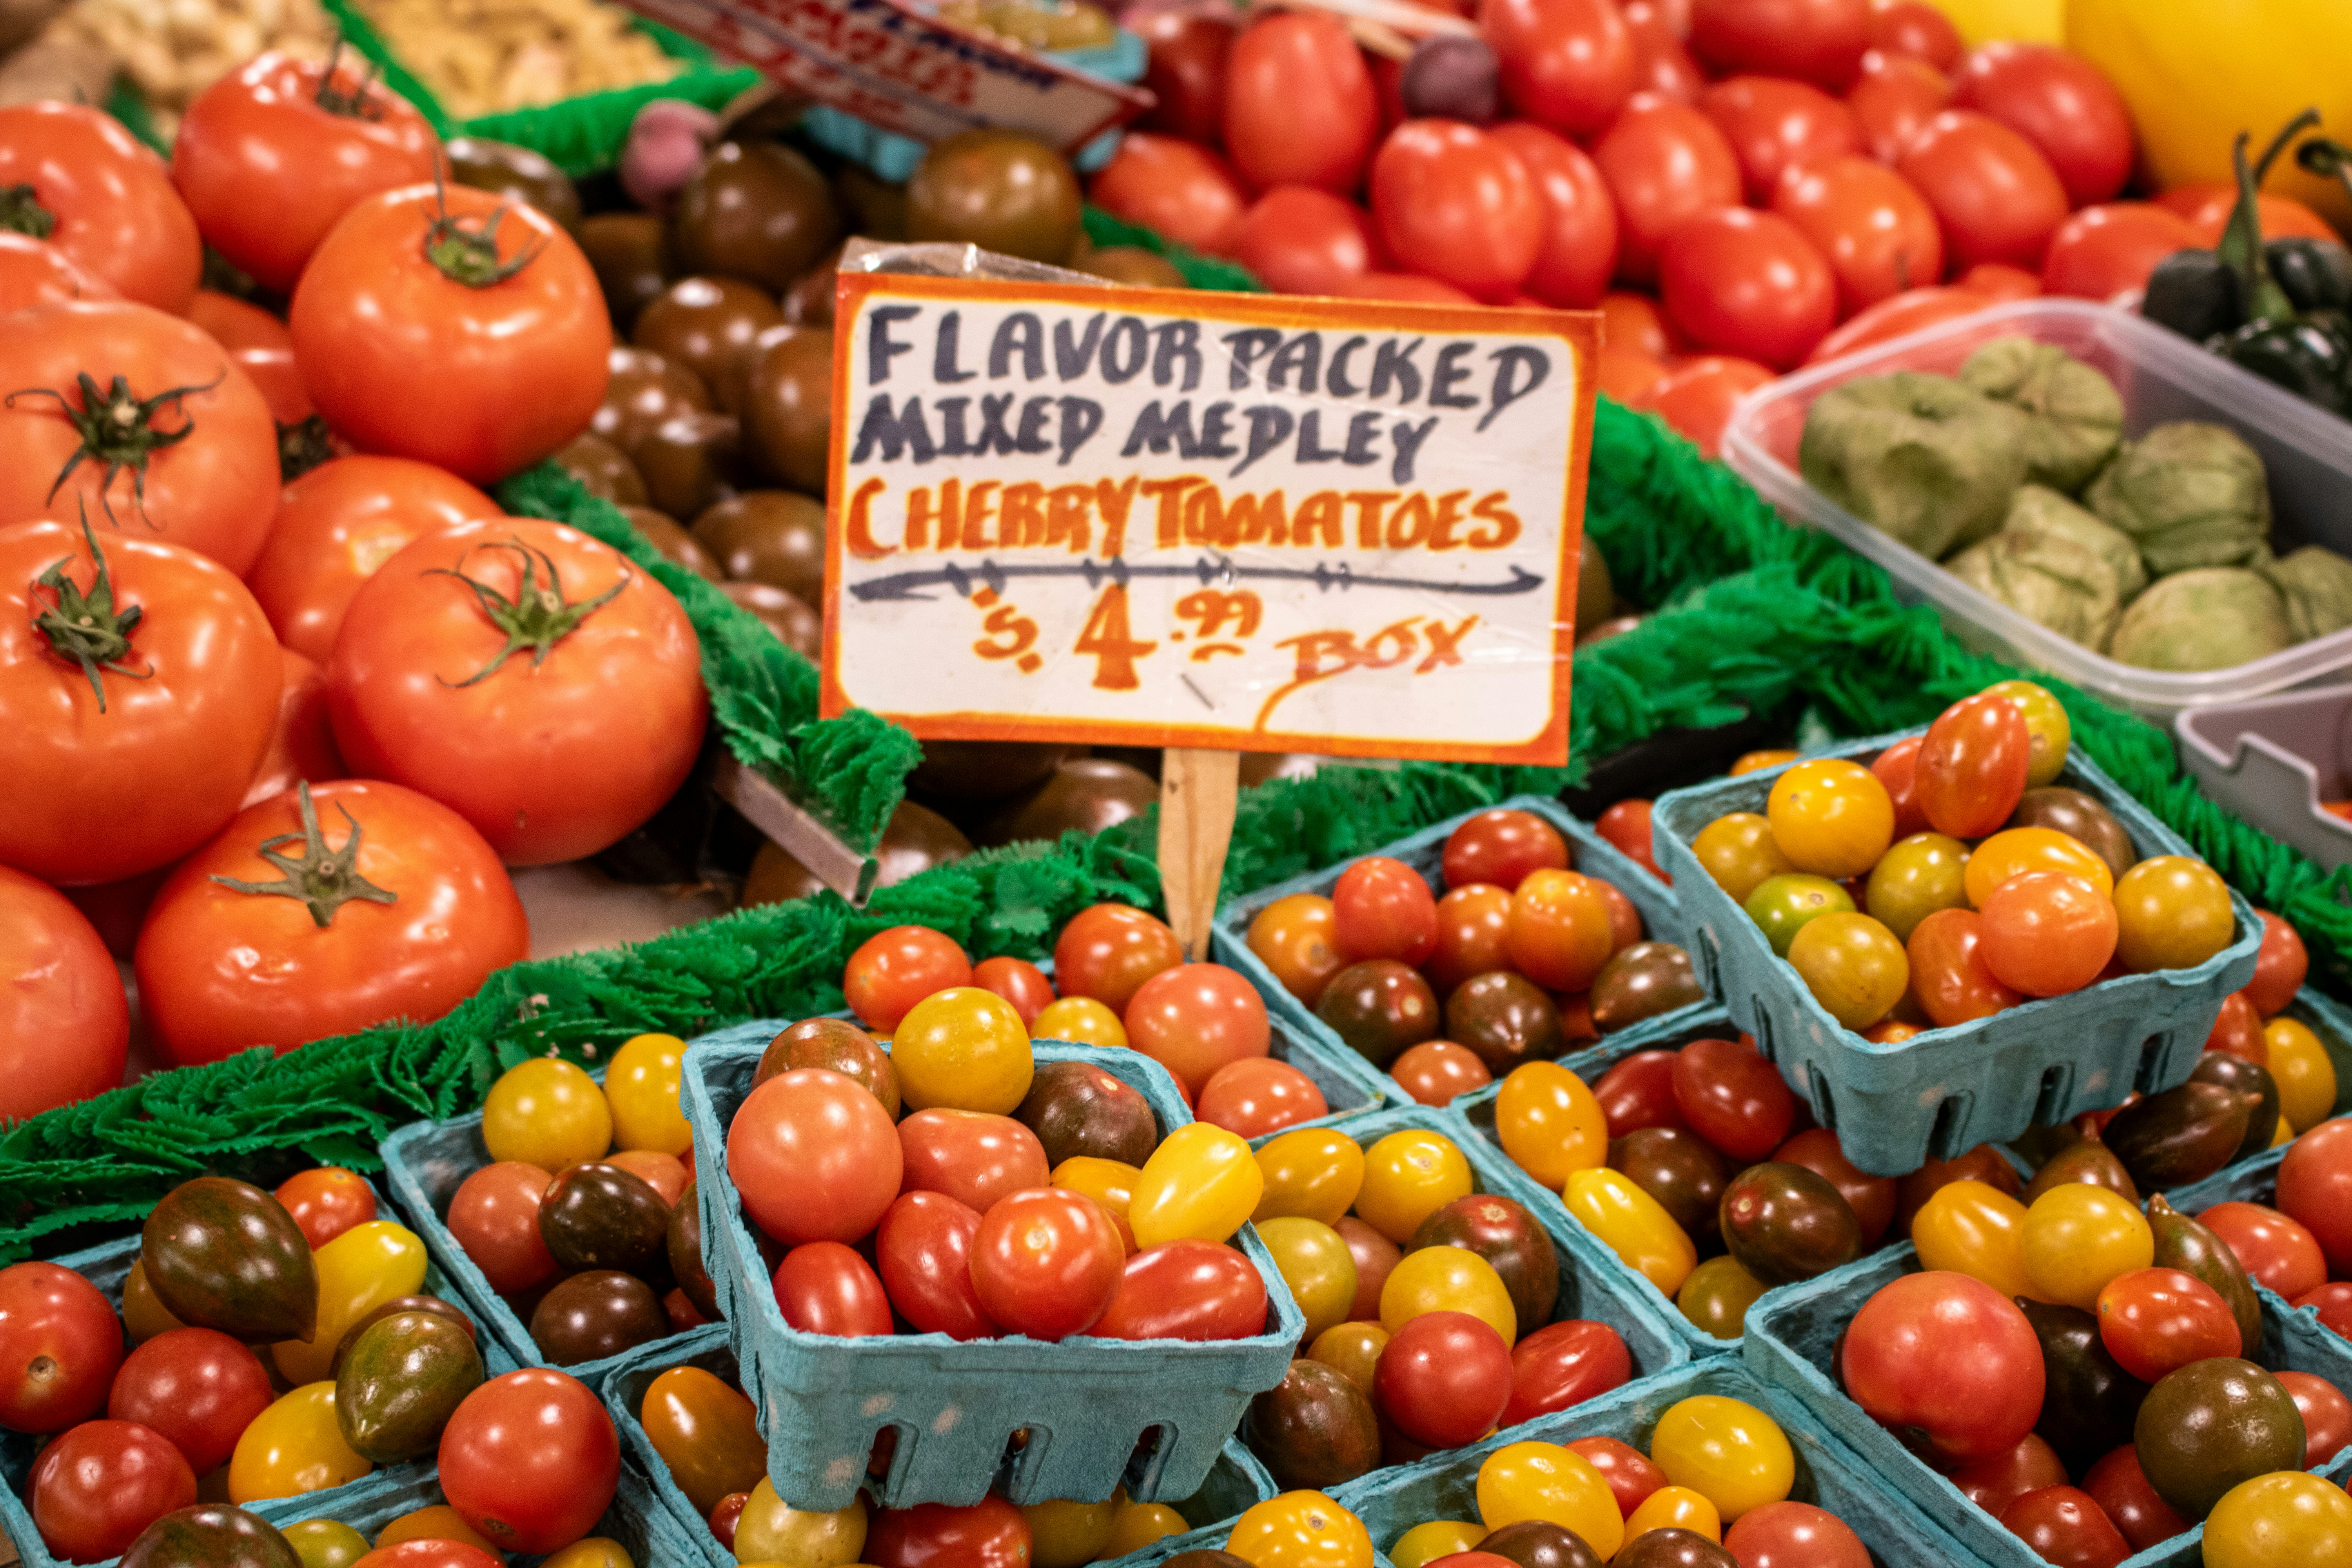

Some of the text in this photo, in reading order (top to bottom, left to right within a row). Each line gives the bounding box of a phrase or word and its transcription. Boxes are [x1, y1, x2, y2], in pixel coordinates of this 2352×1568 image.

[868, 305, 1550, 432] FLAVOR PACKED
[850, 393, 1439, 485] MIXED MEDLEY
[846, 475, 1521, 558] CHERRY TOMATOES
[1254, 613, 1480, 734] BOX
